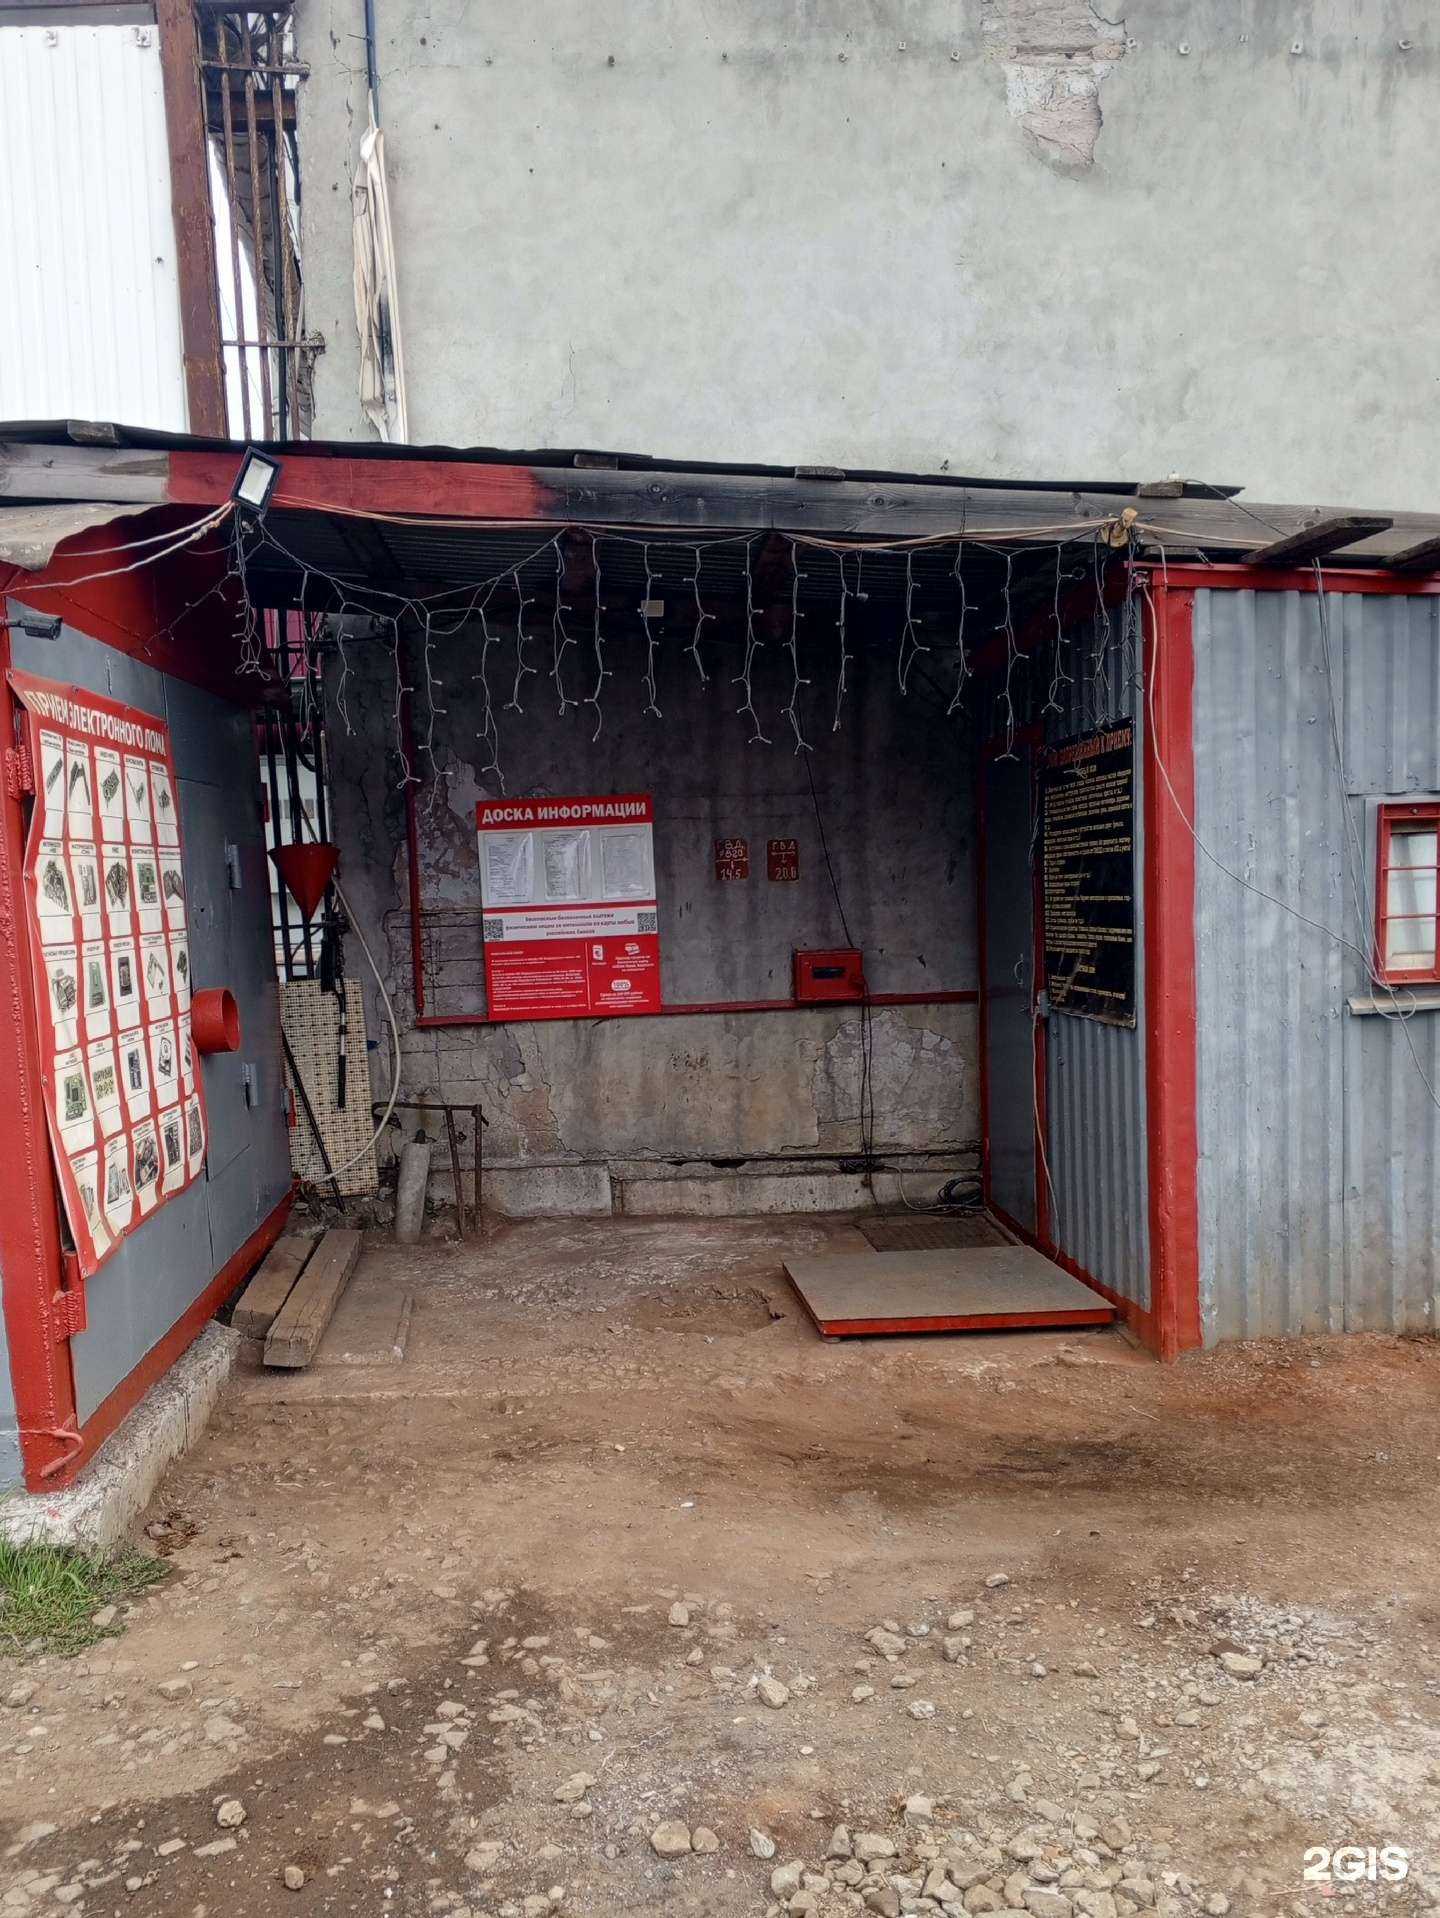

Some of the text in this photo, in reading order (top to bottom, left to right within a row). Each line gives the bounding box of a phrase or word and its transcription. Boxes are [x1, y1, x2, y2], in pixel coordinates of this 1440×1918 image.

[24, 691, 69, 726] ПРИЕМ
[68, 702, 144, 748] ЭЛЕКТРОННОГО
[144, 729, 166, 757] ЛОМА
[482, 802, 646, 825] ДОСКА ИНФОРМАЦИИ
